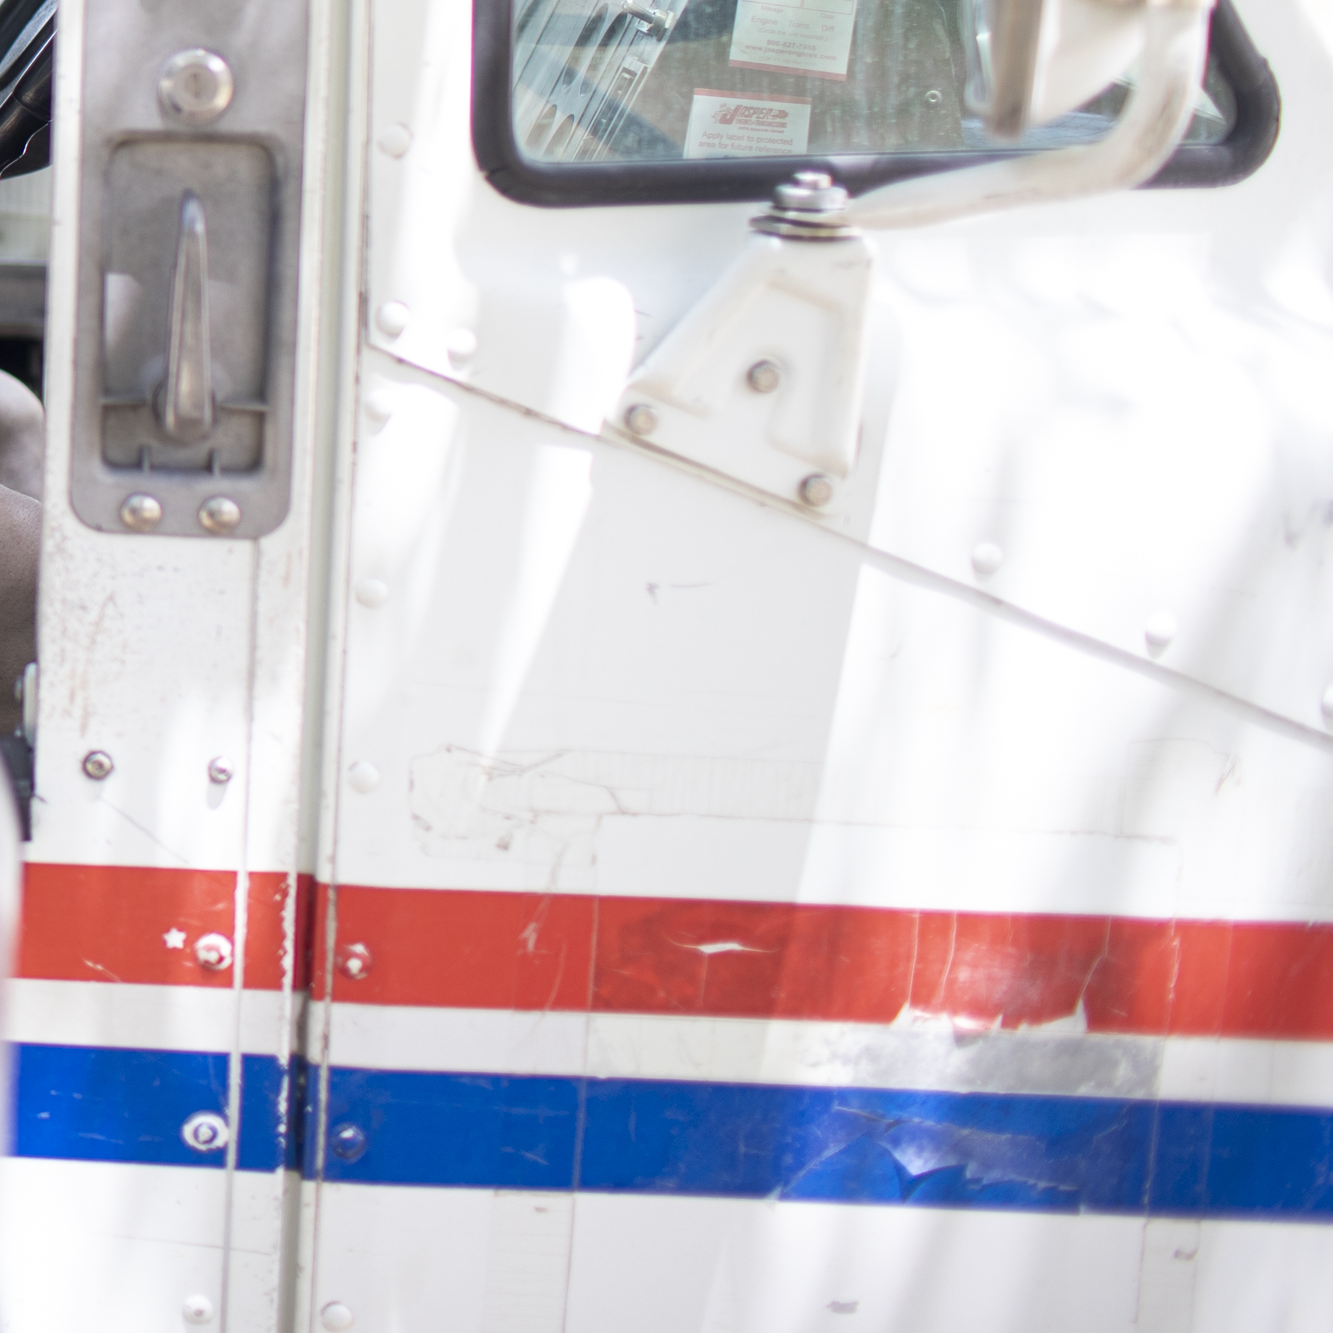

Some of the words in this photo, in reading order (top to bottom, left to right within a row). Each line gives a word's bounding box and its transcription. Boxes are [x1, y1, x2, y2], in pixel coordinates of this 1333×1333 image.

[751, 16, 778, 25] Engine
[718, 104, 772, 125] JASPER
[702, 131, 724, 141] Apply
[726, 133, 744, 141] label
[756, 135, 793, 145] protected
[718, 141, 729, 149] for
[730, 143, 753, 151] future
